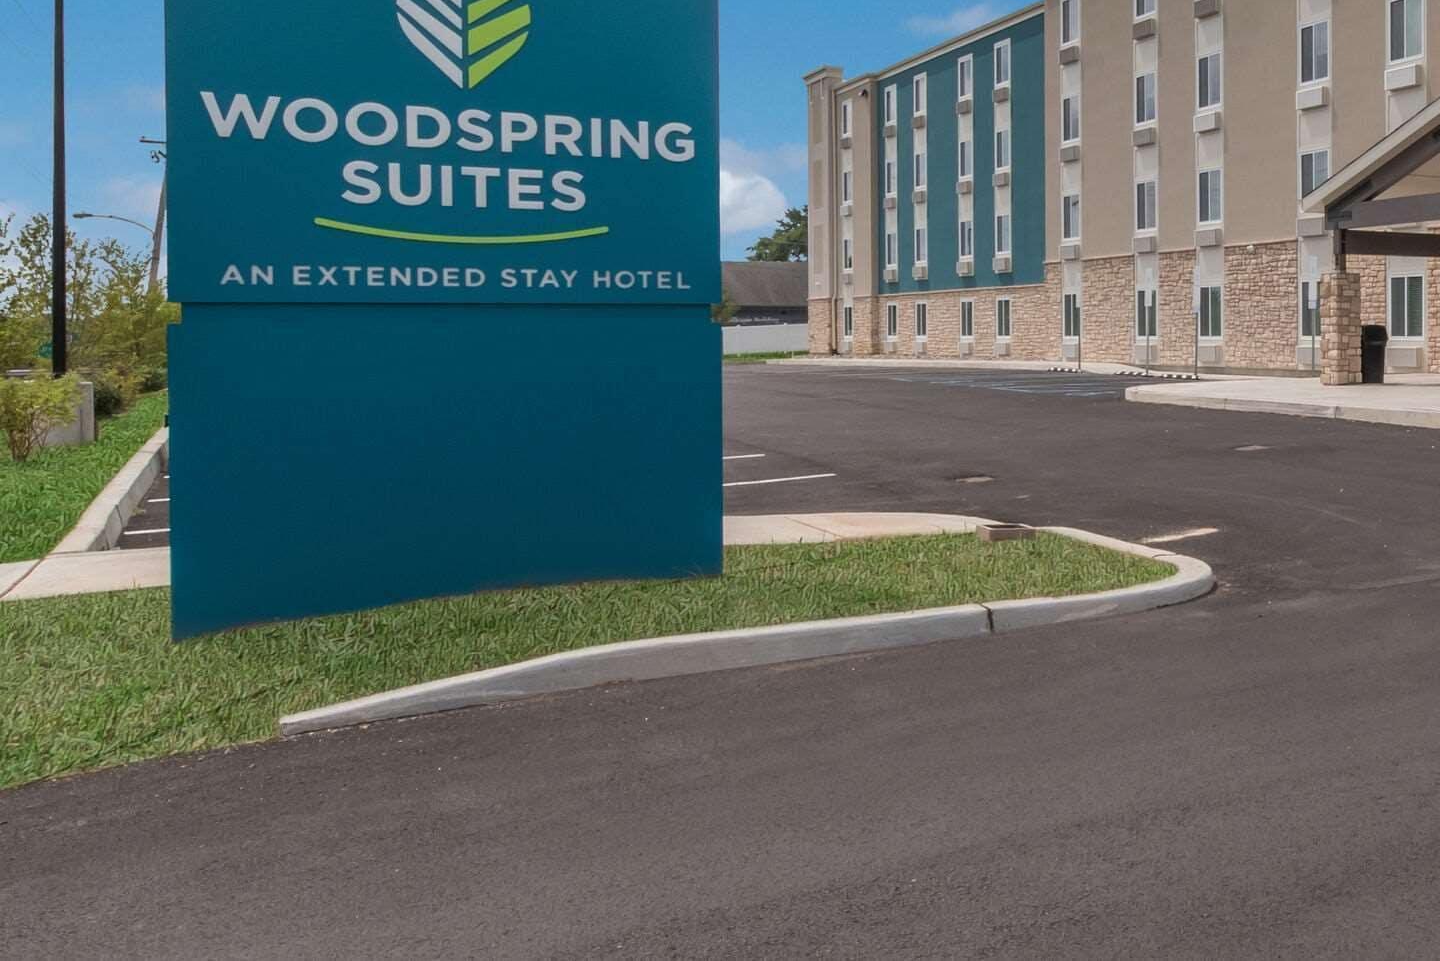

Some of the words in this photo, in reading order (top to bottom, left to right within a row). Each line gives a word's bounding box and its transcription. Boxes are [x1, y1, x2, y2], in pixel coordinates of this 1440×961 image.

[200, 91, 695, 162] WOODSPRING
[341, 160, 586, 212] SUITES
[220, 264, 274, 285] AN
[292, 265, 486, 287] EXTENDED
[501, 268, 577, 288] STAY
[593, 270, 691, 289] HOTEL
